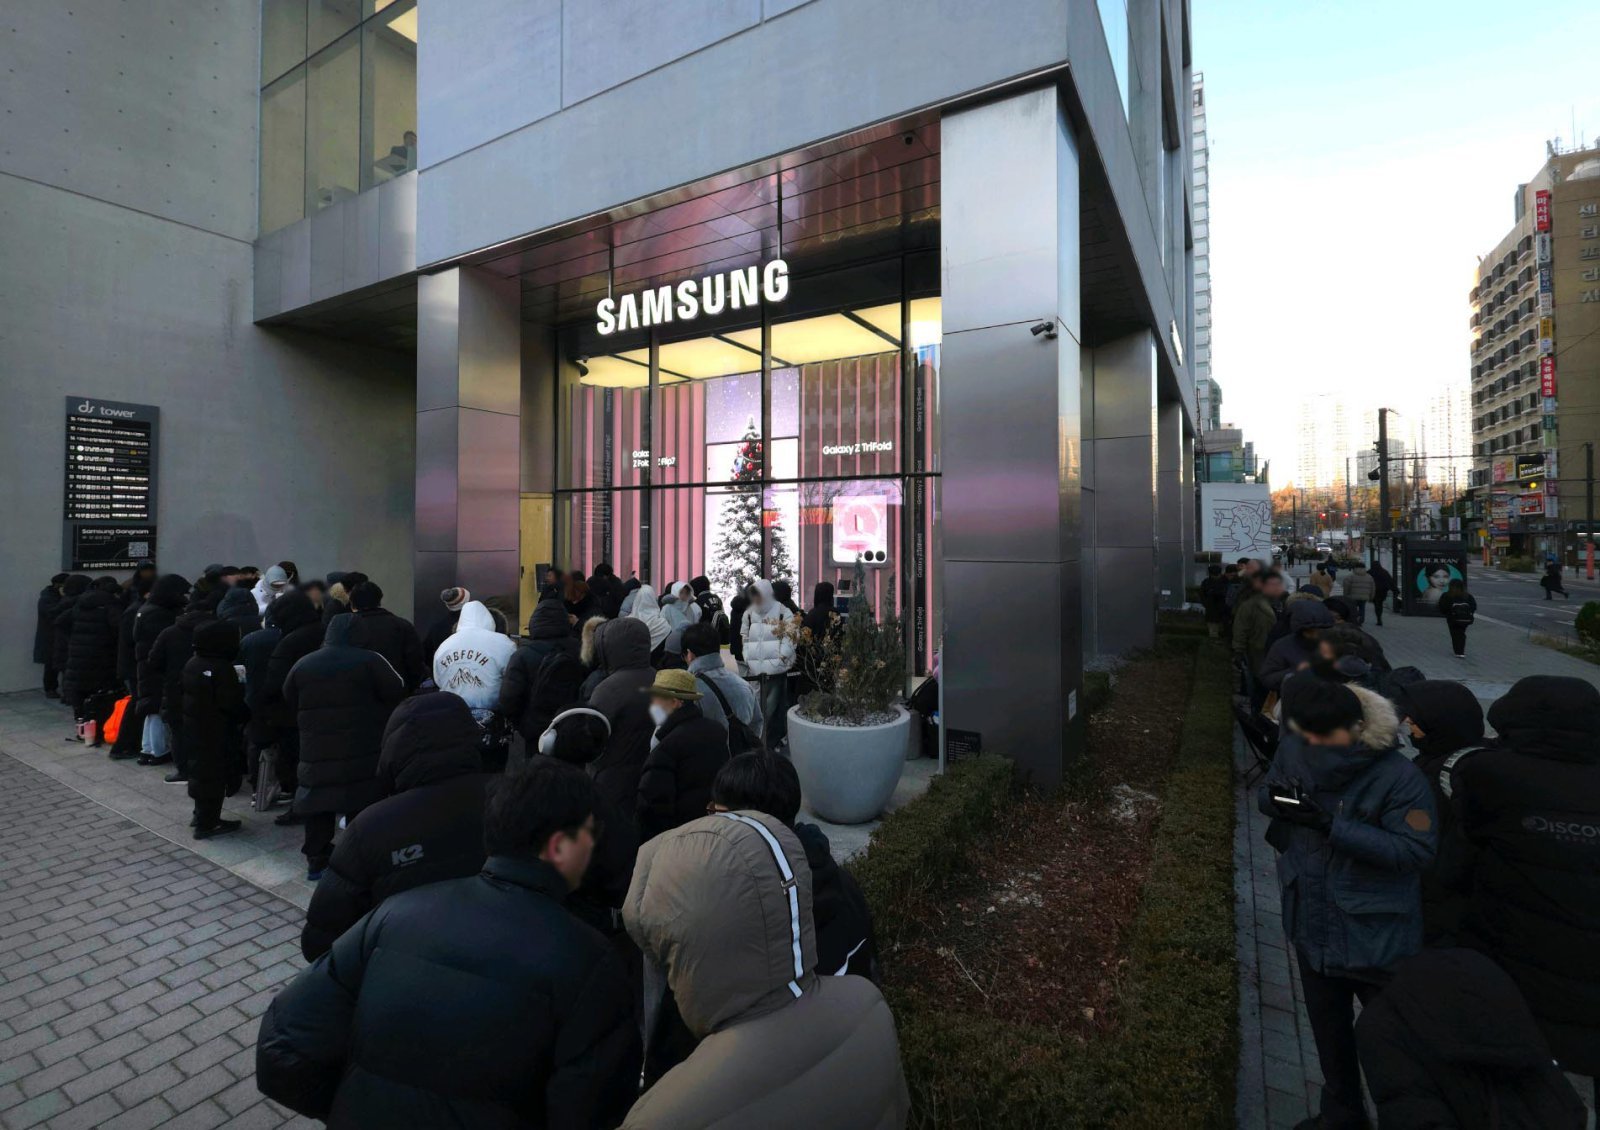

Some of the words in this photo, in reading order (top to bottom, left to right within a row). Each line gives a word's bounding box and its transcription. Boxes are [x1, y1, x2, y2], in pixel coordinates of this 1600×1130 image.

[1537, 197, 1548, 223] 마사지
[596, 259, 789, 335] SAMSUNG
[100, 406, 135, 418] tower
[822, 445, 854, 455] Galaxy
[854, 443, 861, 453] Z
[861, 441, 892, 452] TriFold
[391, 844, 424, 865] K2
